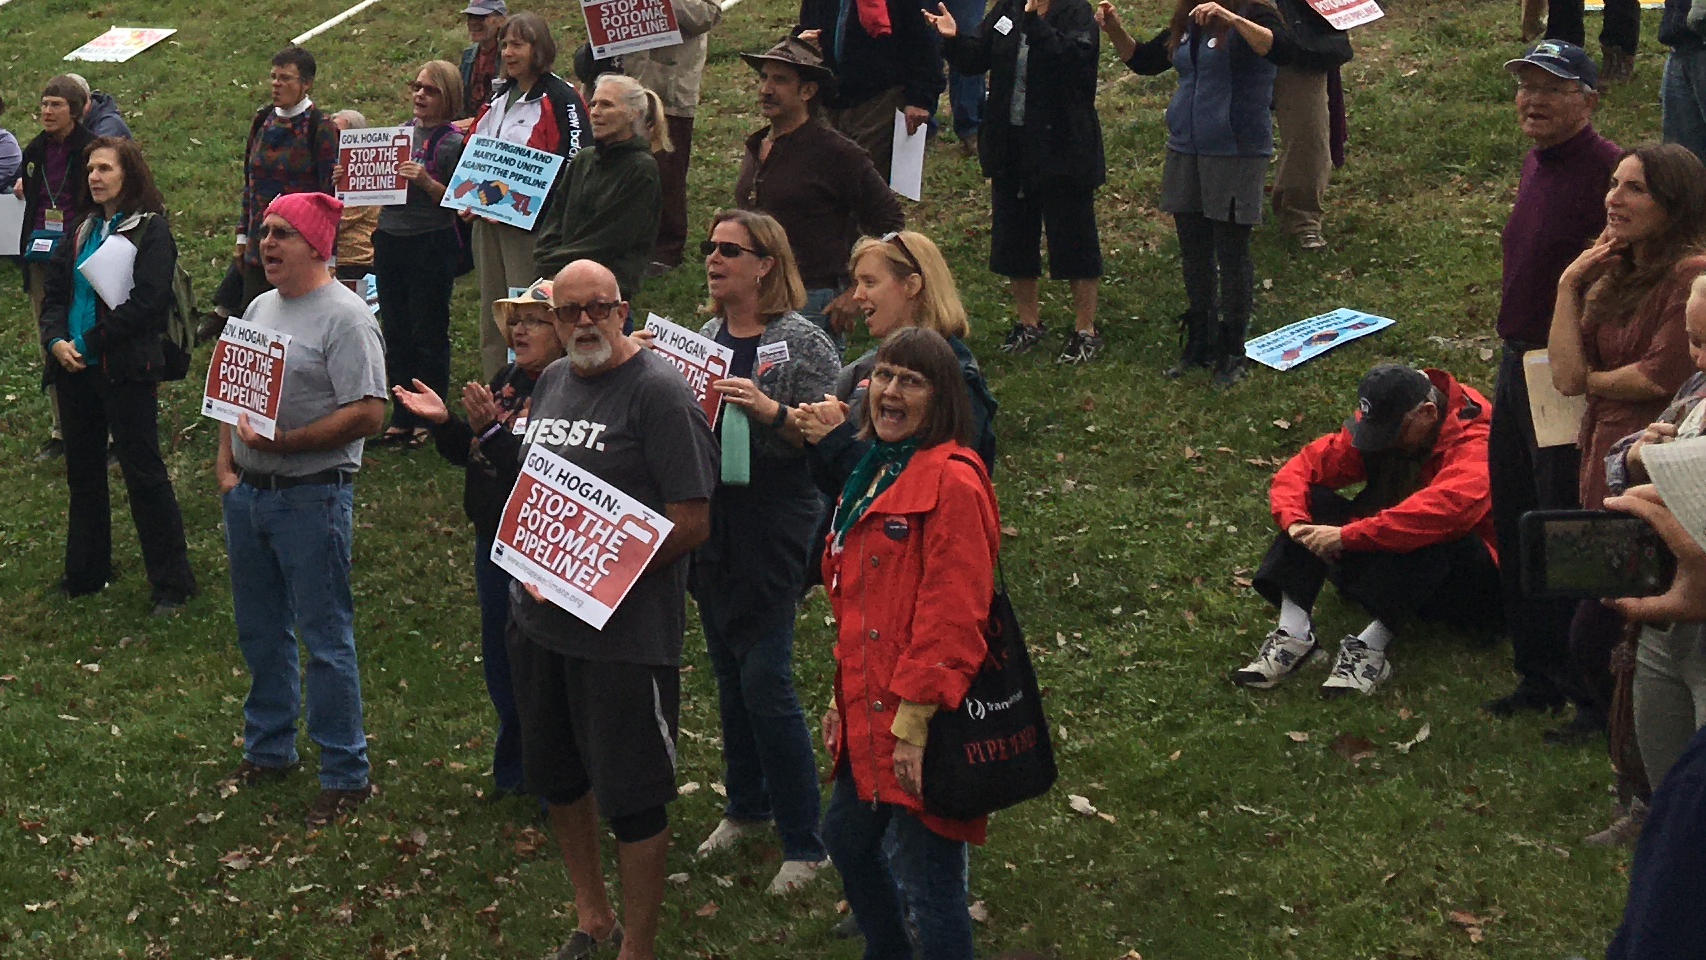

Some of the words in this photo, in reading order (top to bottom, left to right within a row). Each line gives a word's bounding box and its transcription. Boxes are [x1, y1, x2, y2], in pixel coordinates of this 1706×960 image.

[600, 5, 668, 30] POTOMAC
[606, 18, 670, 41] PIPELINE!
[566, 103, 580, 128] new
[341, 133, 360, 145] GOV.
[361, 132, 392, 144] HOGAN:
[475, 137, 495, 149] WEST
[494, 140, 531, 158] VIRGINIA
[532, 152, 553, 165] AND
[349, 148, 377, 163] STOP
[377, 147, 399, 161] THE
[473, 149, 516, 167] MARYLAND
[517, 160, 544, 176] UNITE
[347, 161, 400, 177] POTOMAC
[461, 159, 492, 173] AGAINST
[492, 167, 508, 178] THE
[508, 172, 548, 190] PIPELINE
[349, 175, 396, 191] PIPELINE!
[238, 327, 268, 348] HOGAN:
[647, 321, 668, 343] GOV.
[670, 332, 708, 361] HOGAN:
[1256, 324, 1311, 349] MARYLAND
[1298, 328, 1316, 338] THE
[223, 344, 254, 368] STOP
[254, 353, 274, 377] THE
[219, 362, 273, 396] POTOMAC
[686, 364, 711, 393] THE
[219, 380, 268, 414] PIPELINE!
[527, 452, 554, 479] GOV.
[555, 468, 622, 516] HOGAN:
[527, 483, 579, 522] STOP
[577, 510, 628, 554] THE
[517, 502, 619, 576] POTOMAC
[512, 528, 602, 592] PIPELINE!
